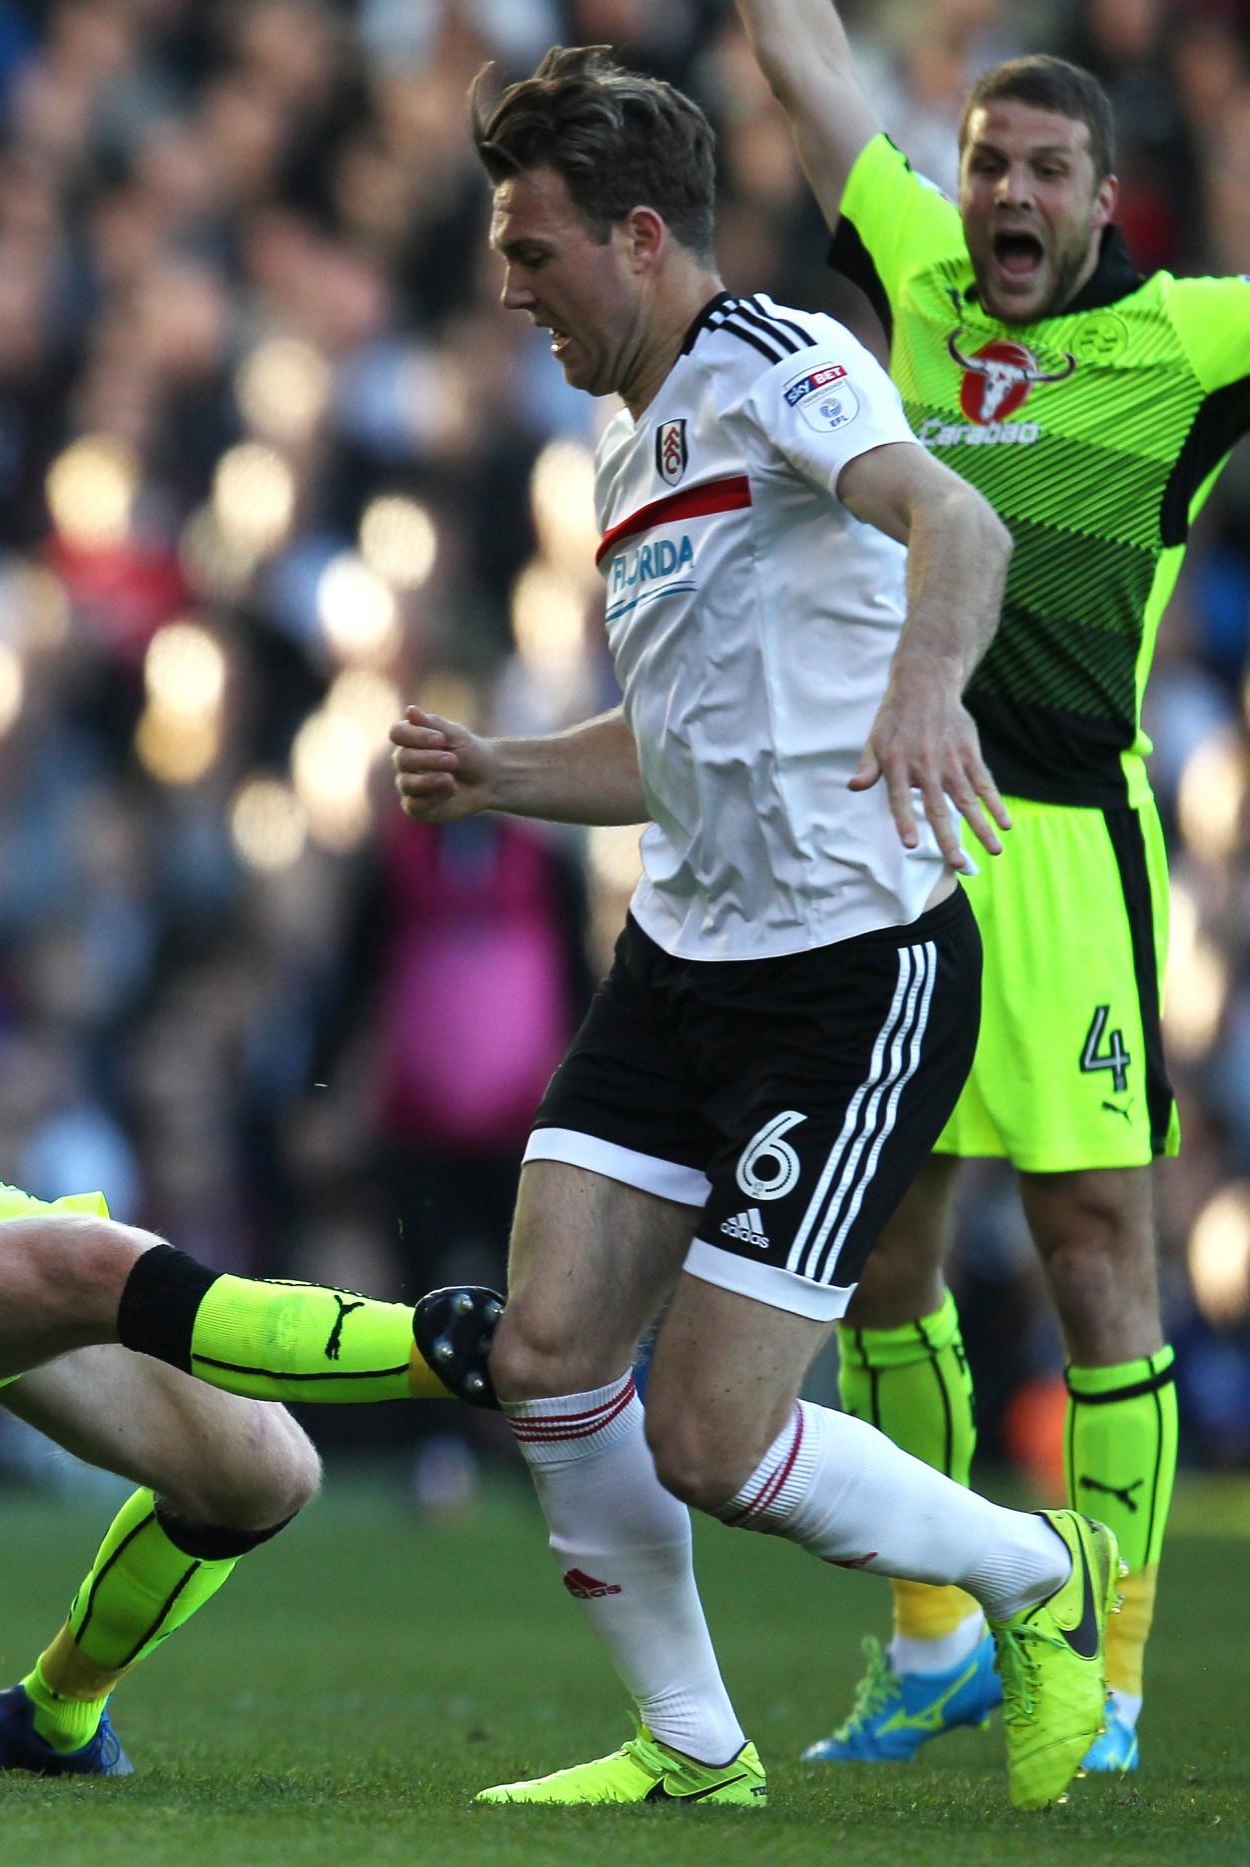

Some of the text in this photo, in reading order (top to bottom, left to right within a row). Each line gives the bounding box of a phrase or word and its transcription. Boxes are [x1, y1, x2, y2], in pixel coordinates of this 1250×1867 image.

[813, 367, 842, 385] BET
[919, 418, 1038, 446] Carabao
[1080, 1005, 1131, 1093] 4
[736, 1110, 808, 1200] 6
[720, 1222, 770, 1249] adidas
